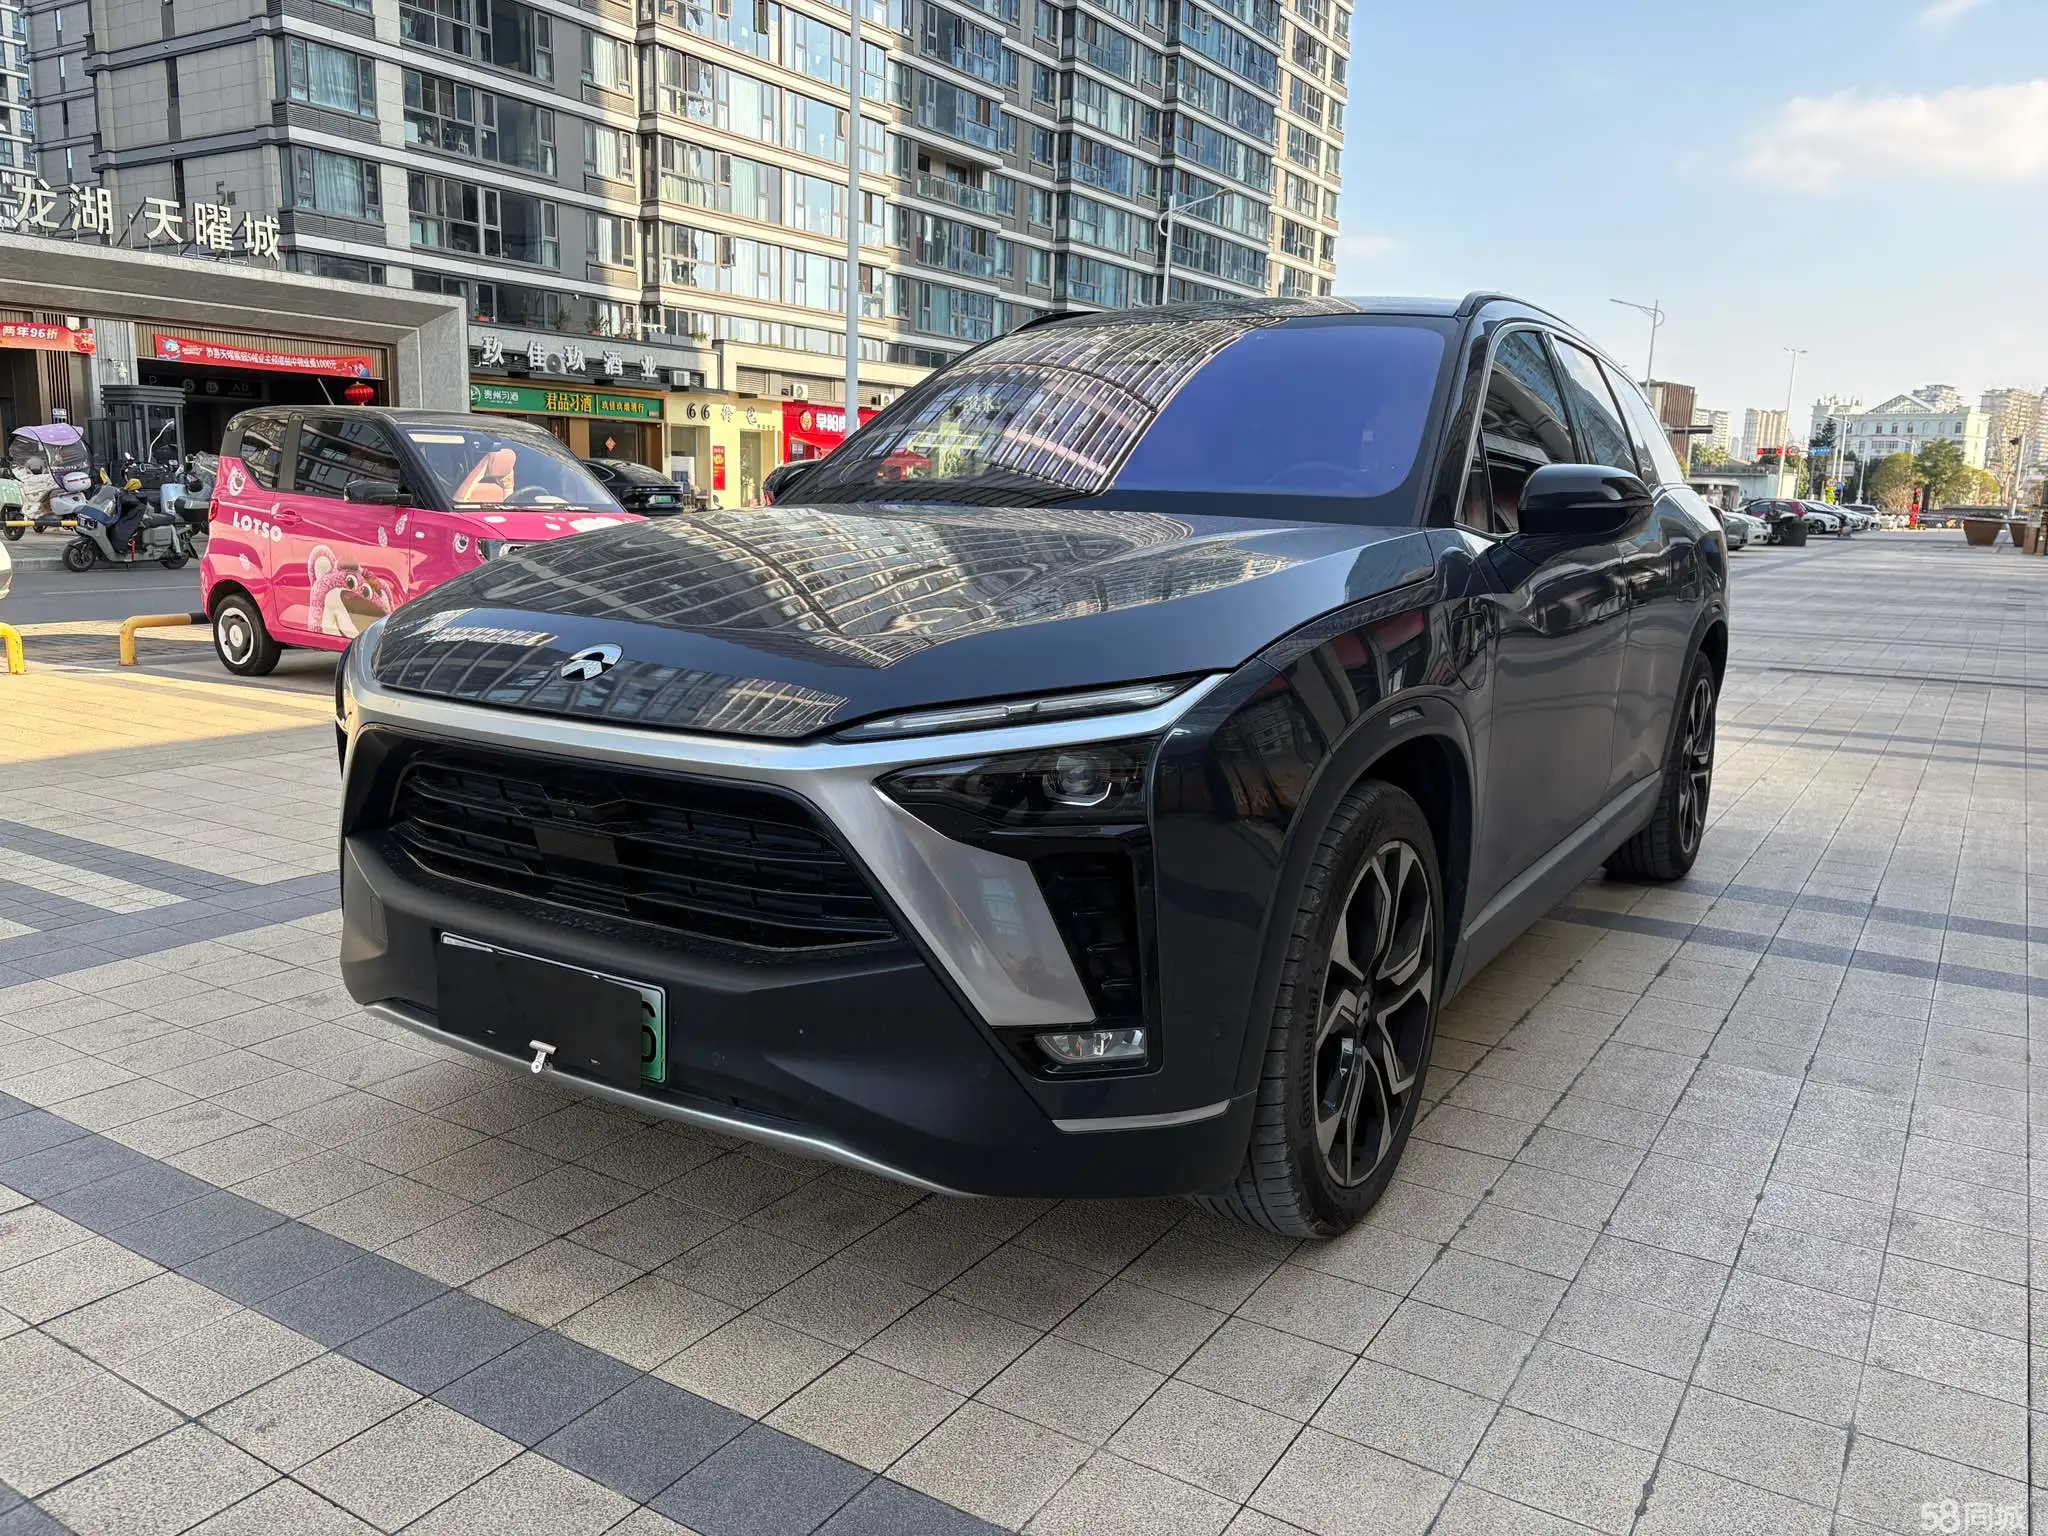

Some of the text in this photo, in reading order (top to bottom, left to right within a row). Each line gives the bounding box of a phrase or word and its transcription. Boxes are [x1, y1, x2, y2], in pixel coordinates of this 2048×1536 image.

[2, 325, 58, 340] 两年96折
[545, 391, 592, 413] 君品习酒
[232, 511, 283, 543] LOTSO
